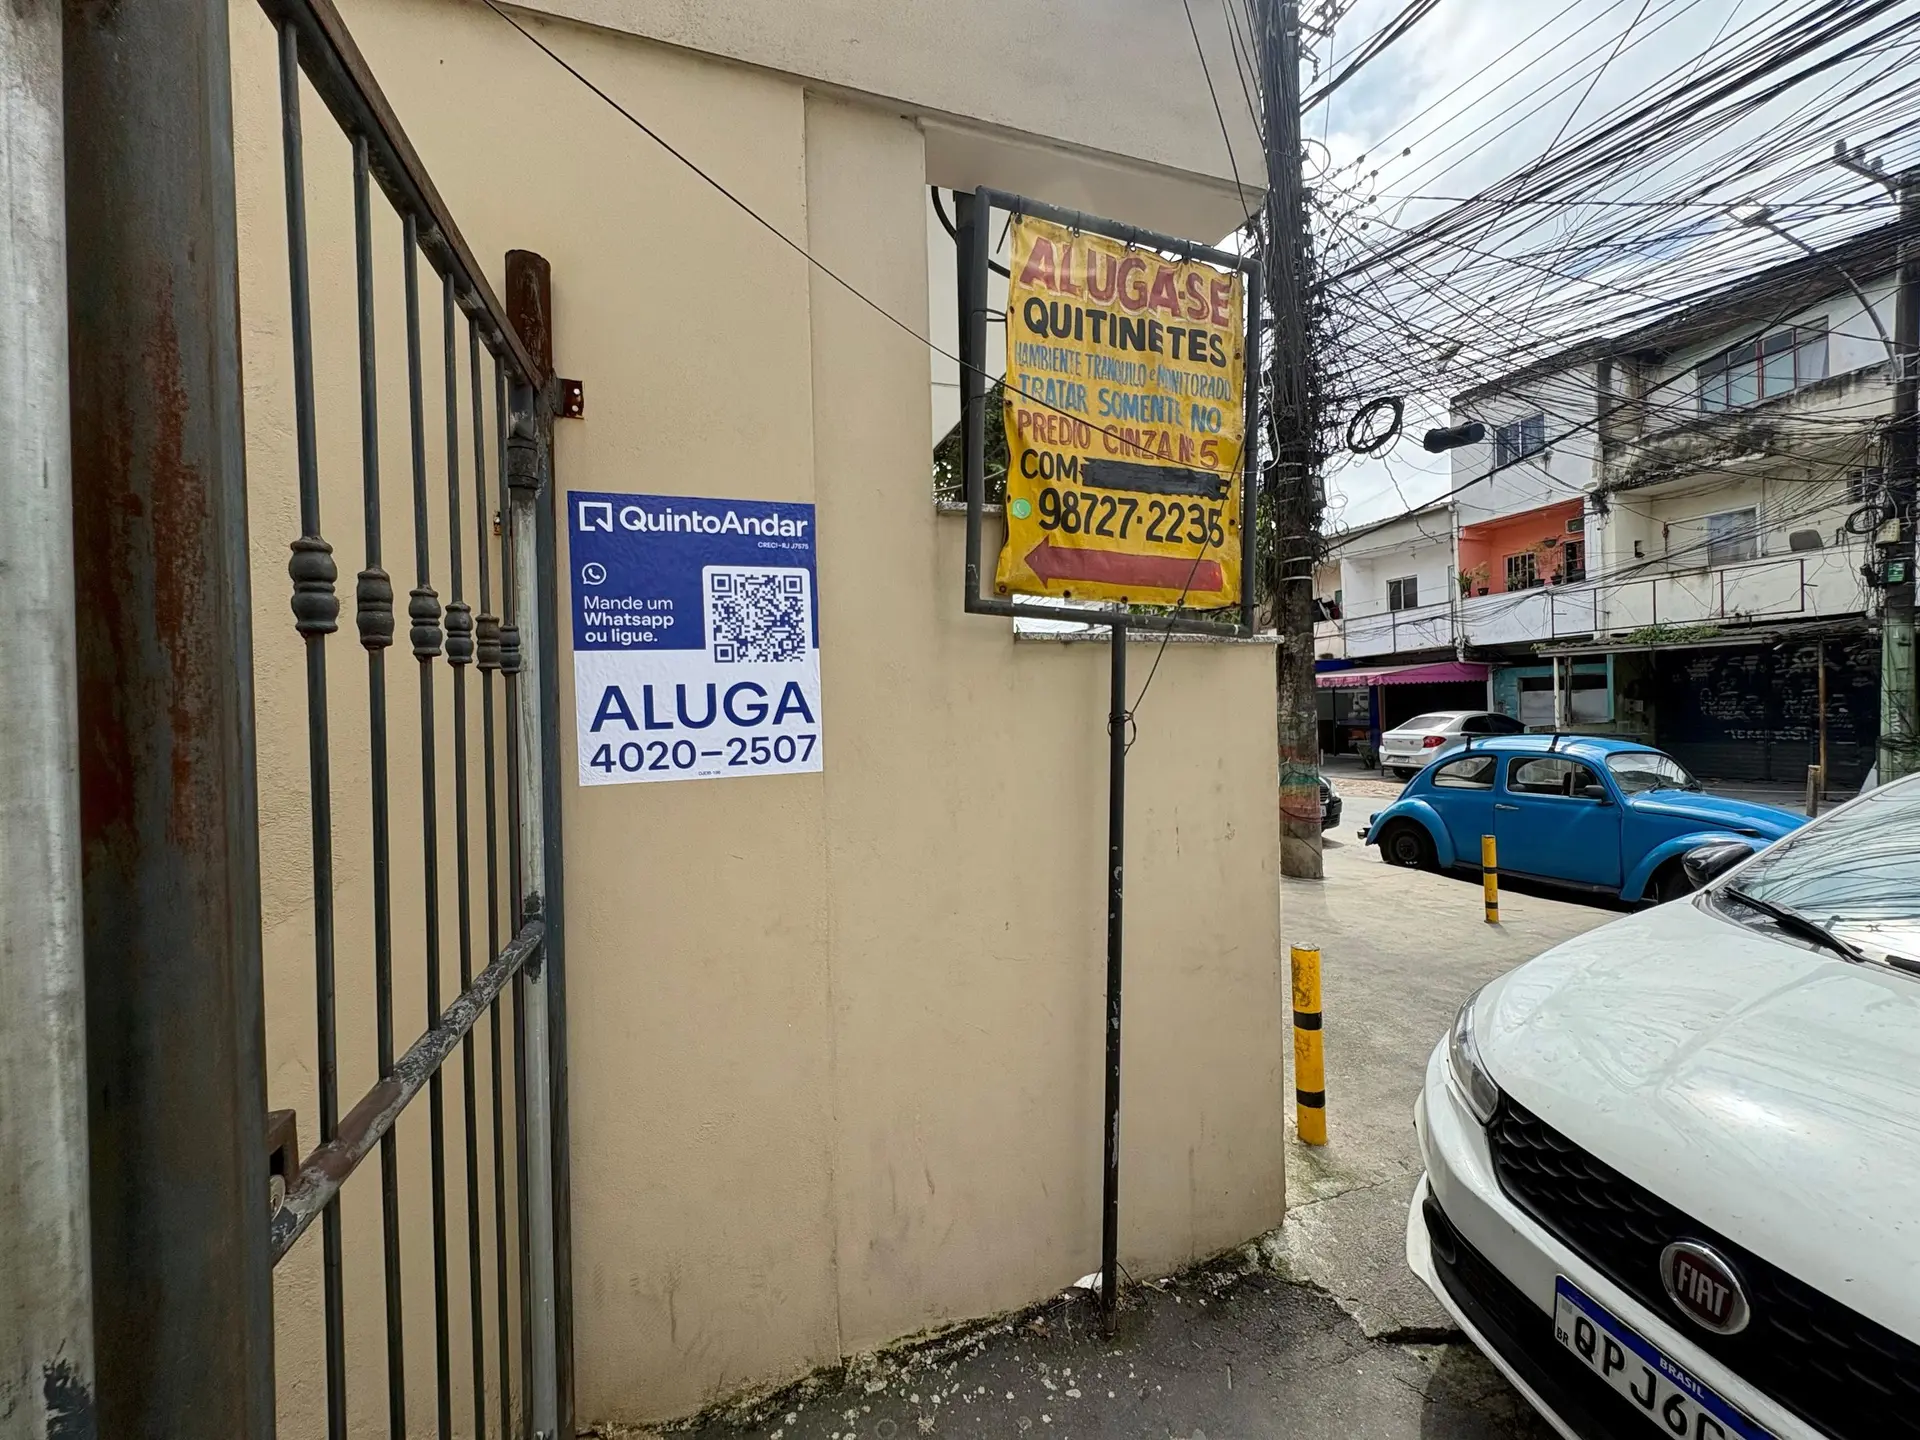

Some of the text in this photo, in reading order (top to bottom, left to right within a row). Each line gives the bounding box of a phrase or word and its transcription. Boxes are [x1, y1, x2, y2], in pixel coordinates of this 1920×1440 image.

[1019, 237, 1231, 328] ALUGA-SE
[1024, 297, 1227, 368] QUITINETES
[1086, 354, 1147, 388] TRANQUILO
[1018, 374, 1222, 434] TRATAR SOMENTE NO
[1017, 409, 1091, 450] PREDIO
[1103, 424, 1173, 461] CINZA
[619, 505, 809, 538] QuintoAndar
[584, 595, 673, 611] Mande um
[584, 612, 675, 629] Whatsapp
[584, 629, 658, 646] ou ligue.
[590, 681, 816, 733] ALUGA
[590, 734, 817, 773] 4020-2507
[1675, 1260, 1730, 1319] FIAT
[1556, 1326, 1569, 1347] BR
[1659, 1357, 1706, 1400] BRASIL
